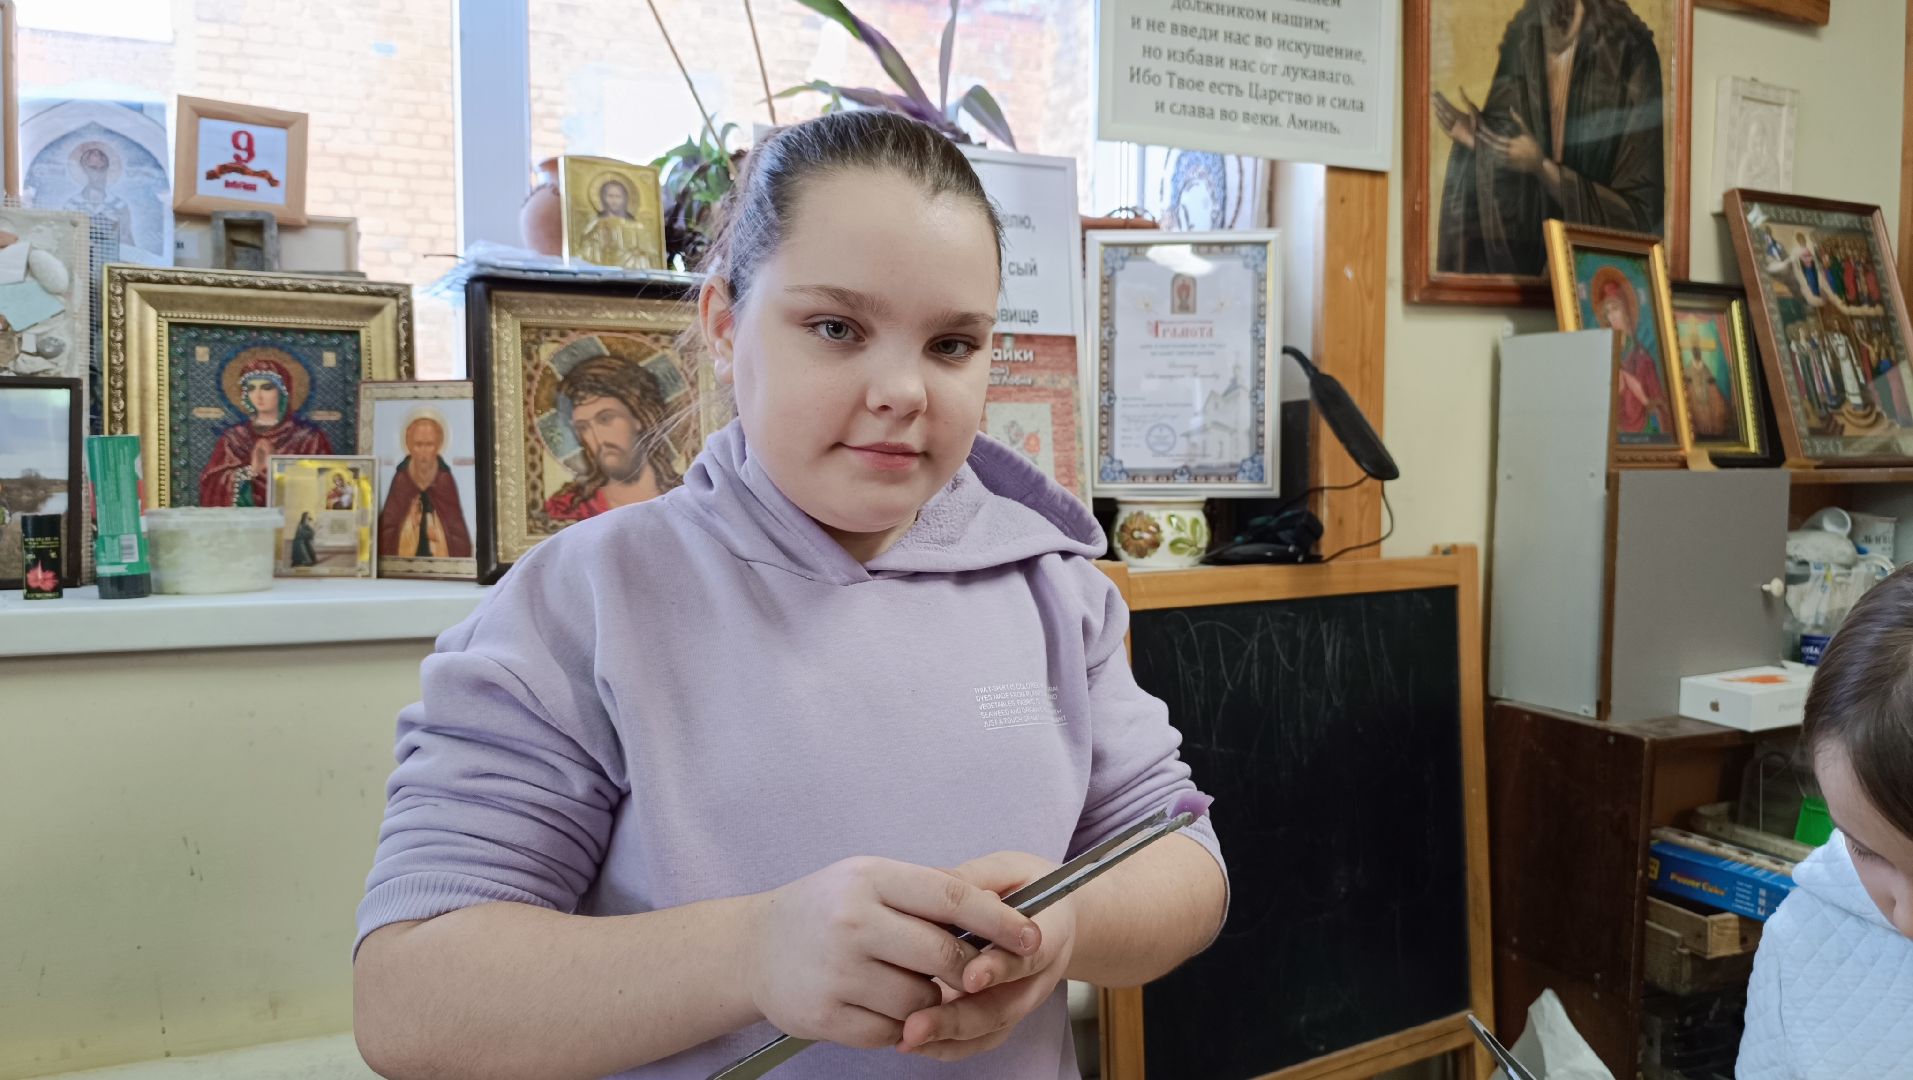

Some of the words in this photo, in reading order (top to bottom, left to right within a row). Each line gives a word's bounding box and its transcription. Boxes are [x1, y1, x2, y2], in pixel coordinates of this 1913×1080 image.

[1170, 0, 1267, 23] должником
[1271, 12, 1331, 34] нашим;
[1131, 15, 1142, 30] и
[1146, 18, 1166, 34] не
[1170, 21, 1218, 42] введи
[1223, 29, 1251, 46] нас
[1254, 34, 1273, 49] во
[1277, 37, 1367, 64] искушение,
[1142, 45, 1163, 60] но
[1167, 47, 1225, 69] избави
[1229, 57, 1256, 73] нас
[1260, 62, 1278, 76] от
[1281, 64, 1355, 87] лукаваго.
[1129, 65, 1162, 87] Ибо
[1165, 69, 1205, 92] Твое
[1208, 81, 1244, 98] есть
[1247, 81, 1313, 106] Царство
[1316, 94, 1327, 108] и
[1330, 96, 1365, 113] сила
[1154, 101, 1165, 114] и
[1169, 102, 1215, 120] слава
[1219, 108, 1239, 122] во
[1242, 111, 1283, 128] веки.
[1287, 112, 1341, 134] Аминь.
[231, 130, 256, 164] 9
[1008, 258, 1039, 277] сый
[991, 348, 1034, 363] айки
